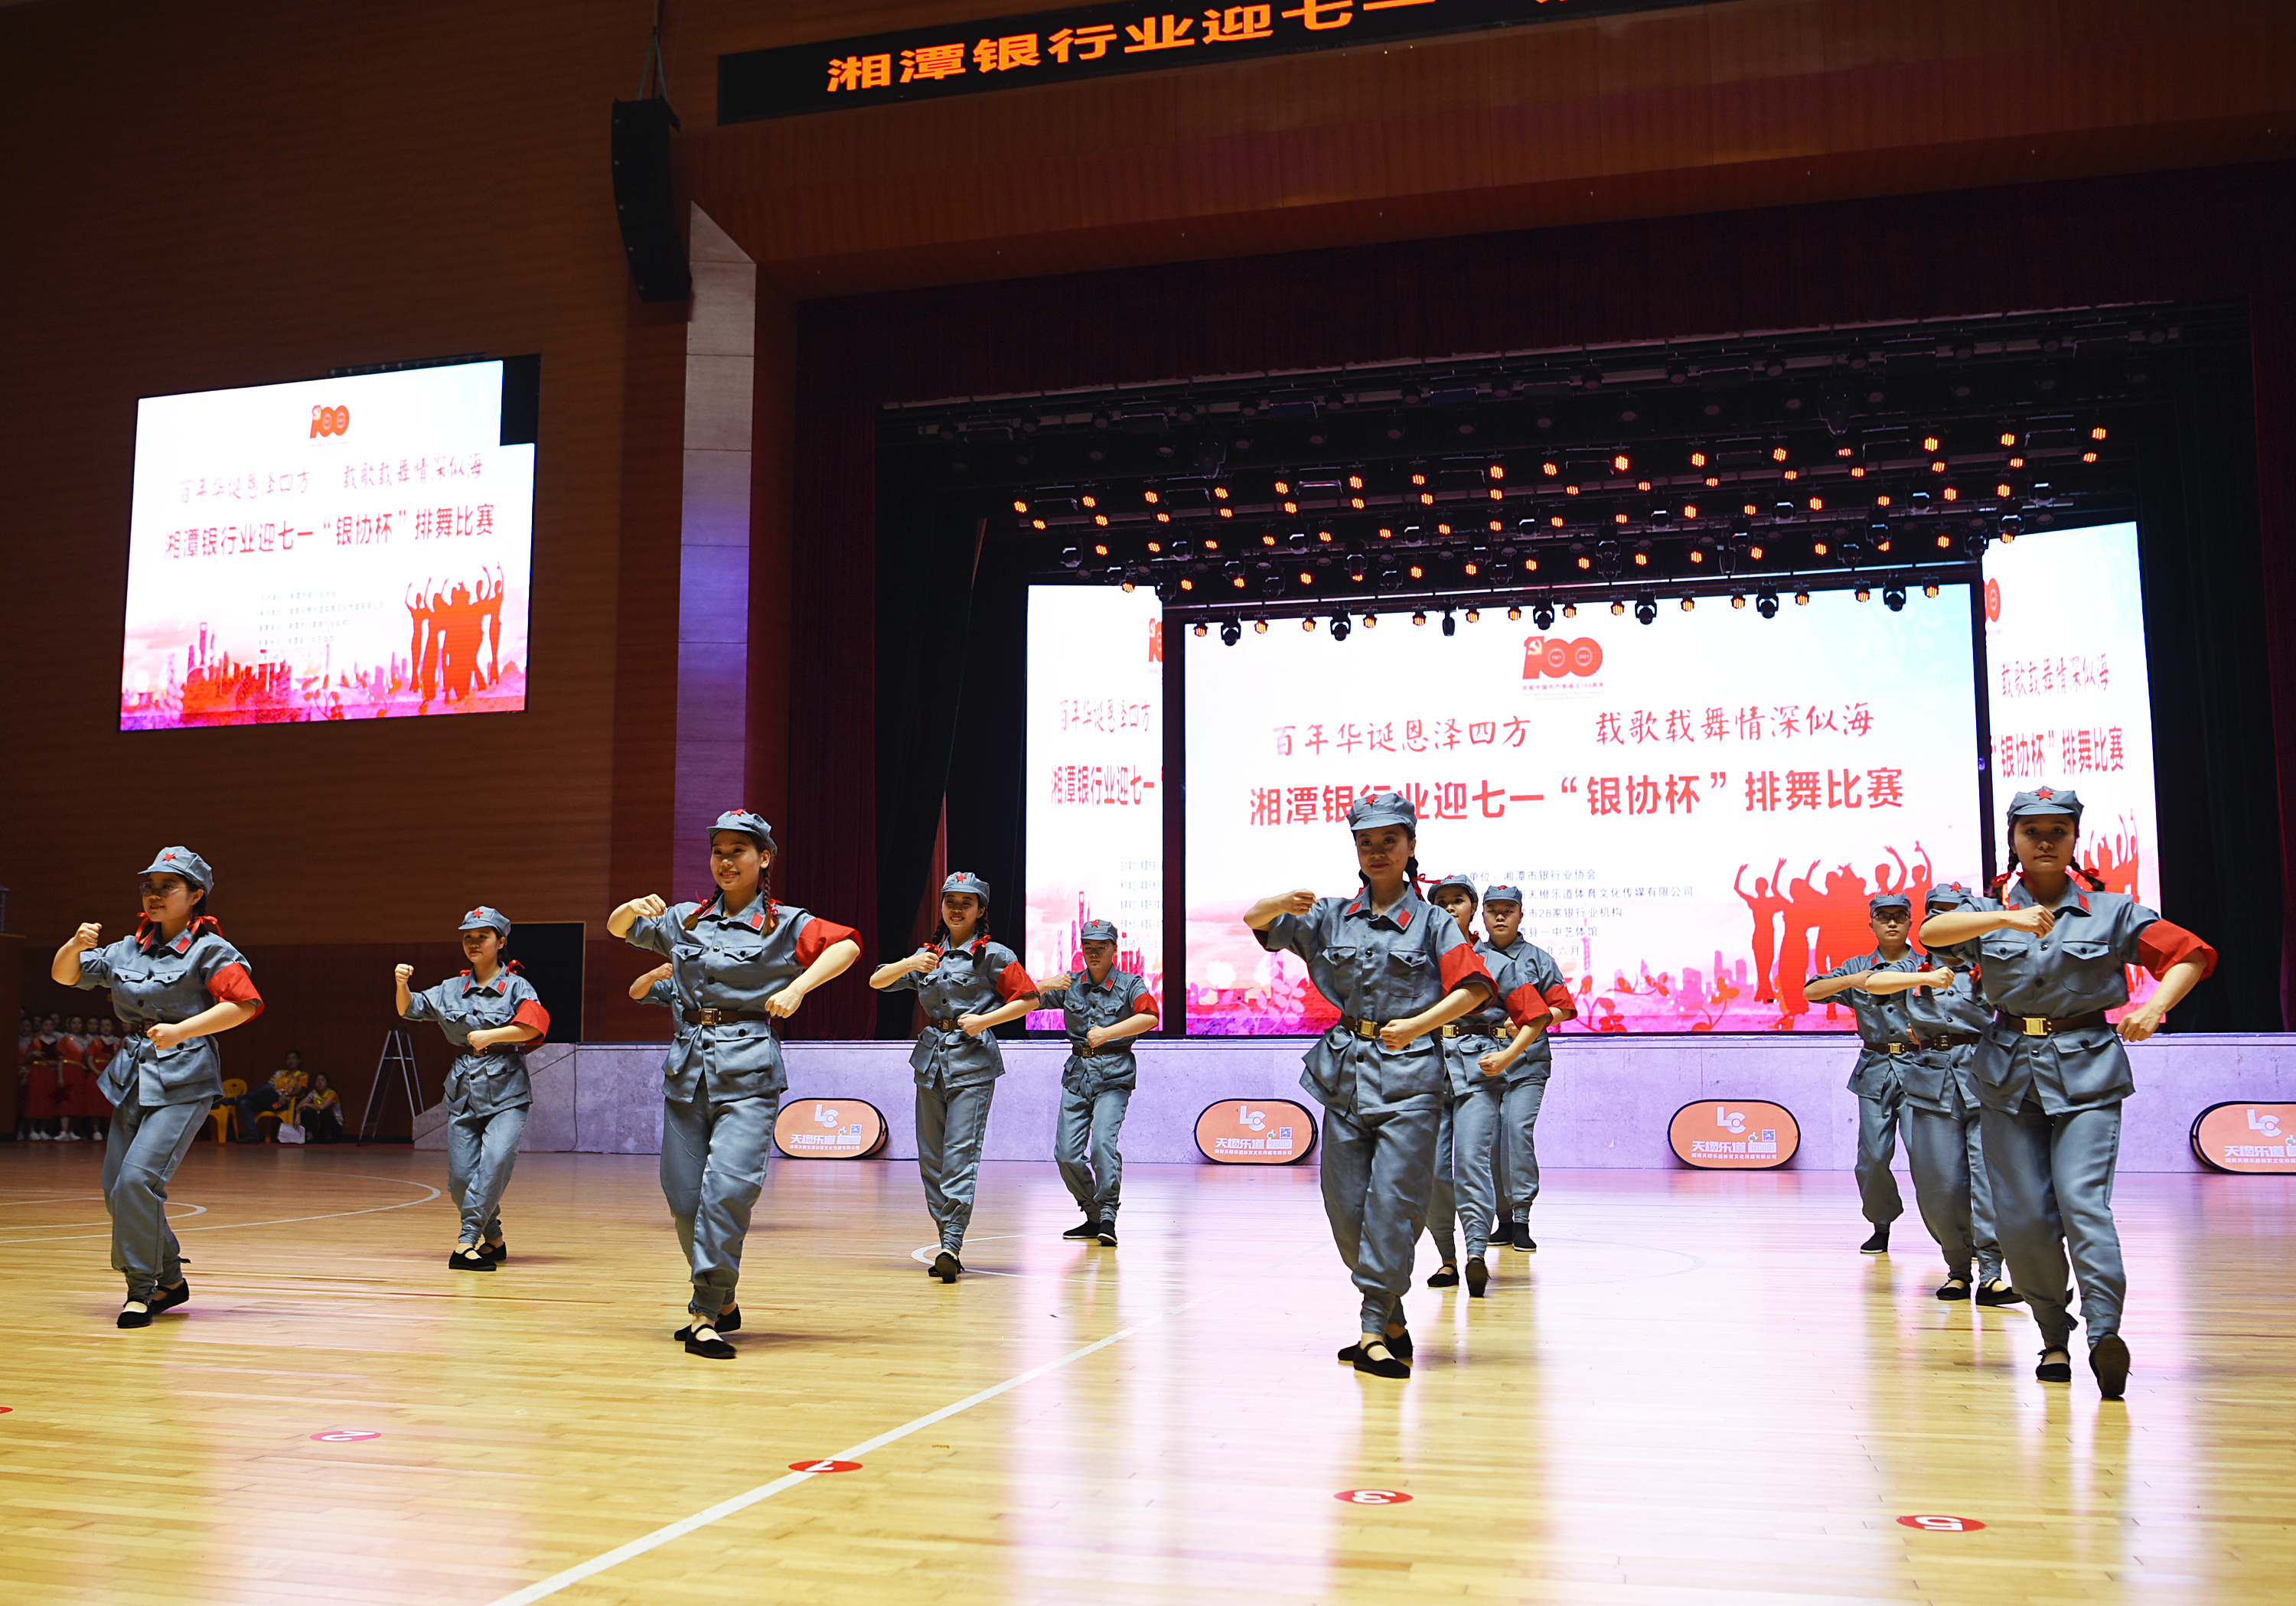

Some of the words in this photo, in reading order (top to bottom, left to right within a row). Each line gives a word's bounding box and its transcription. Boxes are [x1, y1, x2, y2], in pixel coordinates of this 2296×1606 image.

[1060, 699, 1151, 733] 百年华诞恩泽四方
[1272, 715, 1531, 757] 百年华诞恩泽四方
[1595, 702, 1874, 746] 载歌载舞情深似海
[1250, 766, 1904, 826] 湘潭银业迎七一“银协杯”排舞比赛
[1504, 869, 1597, 881] 湘潭市银行业协会
[1521, 907, 1623, 919] 市28家银行业机构
